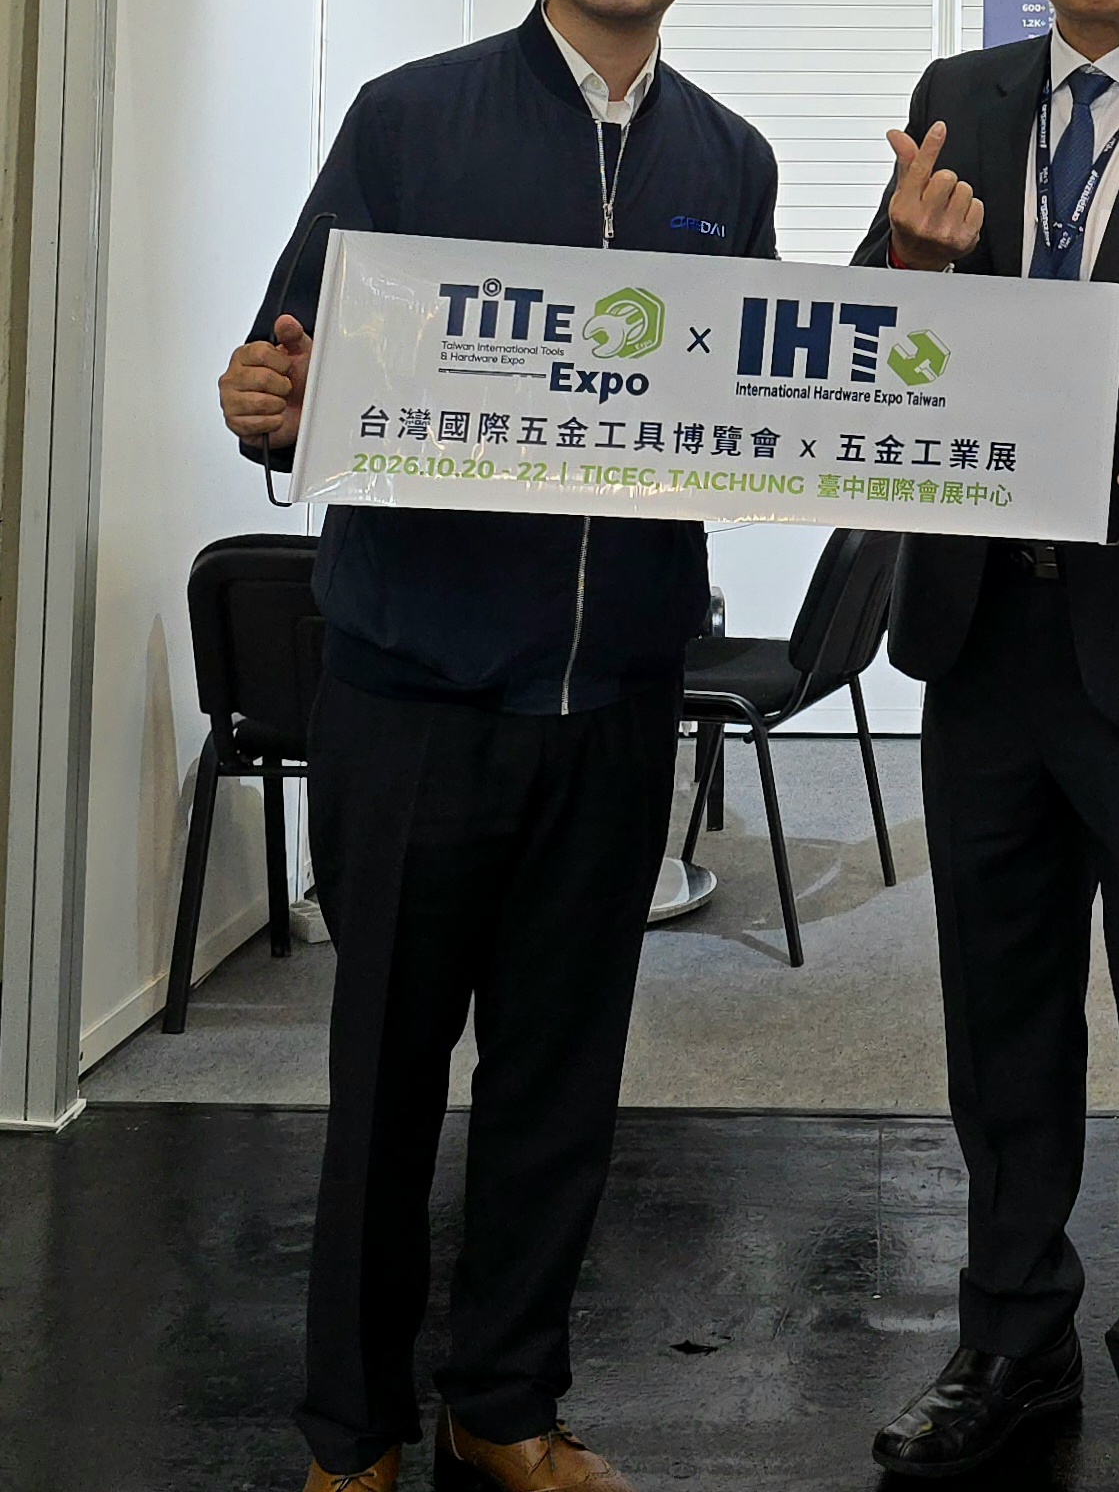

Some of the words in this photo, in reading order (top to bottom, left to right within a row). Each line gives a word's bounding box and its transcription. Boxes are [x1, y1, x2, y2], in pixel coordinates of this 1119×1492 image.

[439, 278, 575, 344] TiTE
[736, 296, 899, 384] IHT
[441, 340, 475, 352] Taiwan
[477, 343, 538, 356] International
[540, 345, 565, 357] Tools
[450, 352, 499, 363] Hardware
[500, 354, 526, 366] Expo
[549, 361, 650, 405] Expo
[735, 381, 811, 400] International
[813, 385, 871, 403] Hardware
[873, 389, 903, 406] Expo
[906, 391, 946, 408] Taiwan
[836, 433, 1017, 473] 五金工業展
[352, 452, 496, 480] 2026.10.20
[517, 461, 548, 483] 22
[668, 468, 805, 496] TAICHUNG
[816, 473, 1014, 508] 臺中國際會展中心
